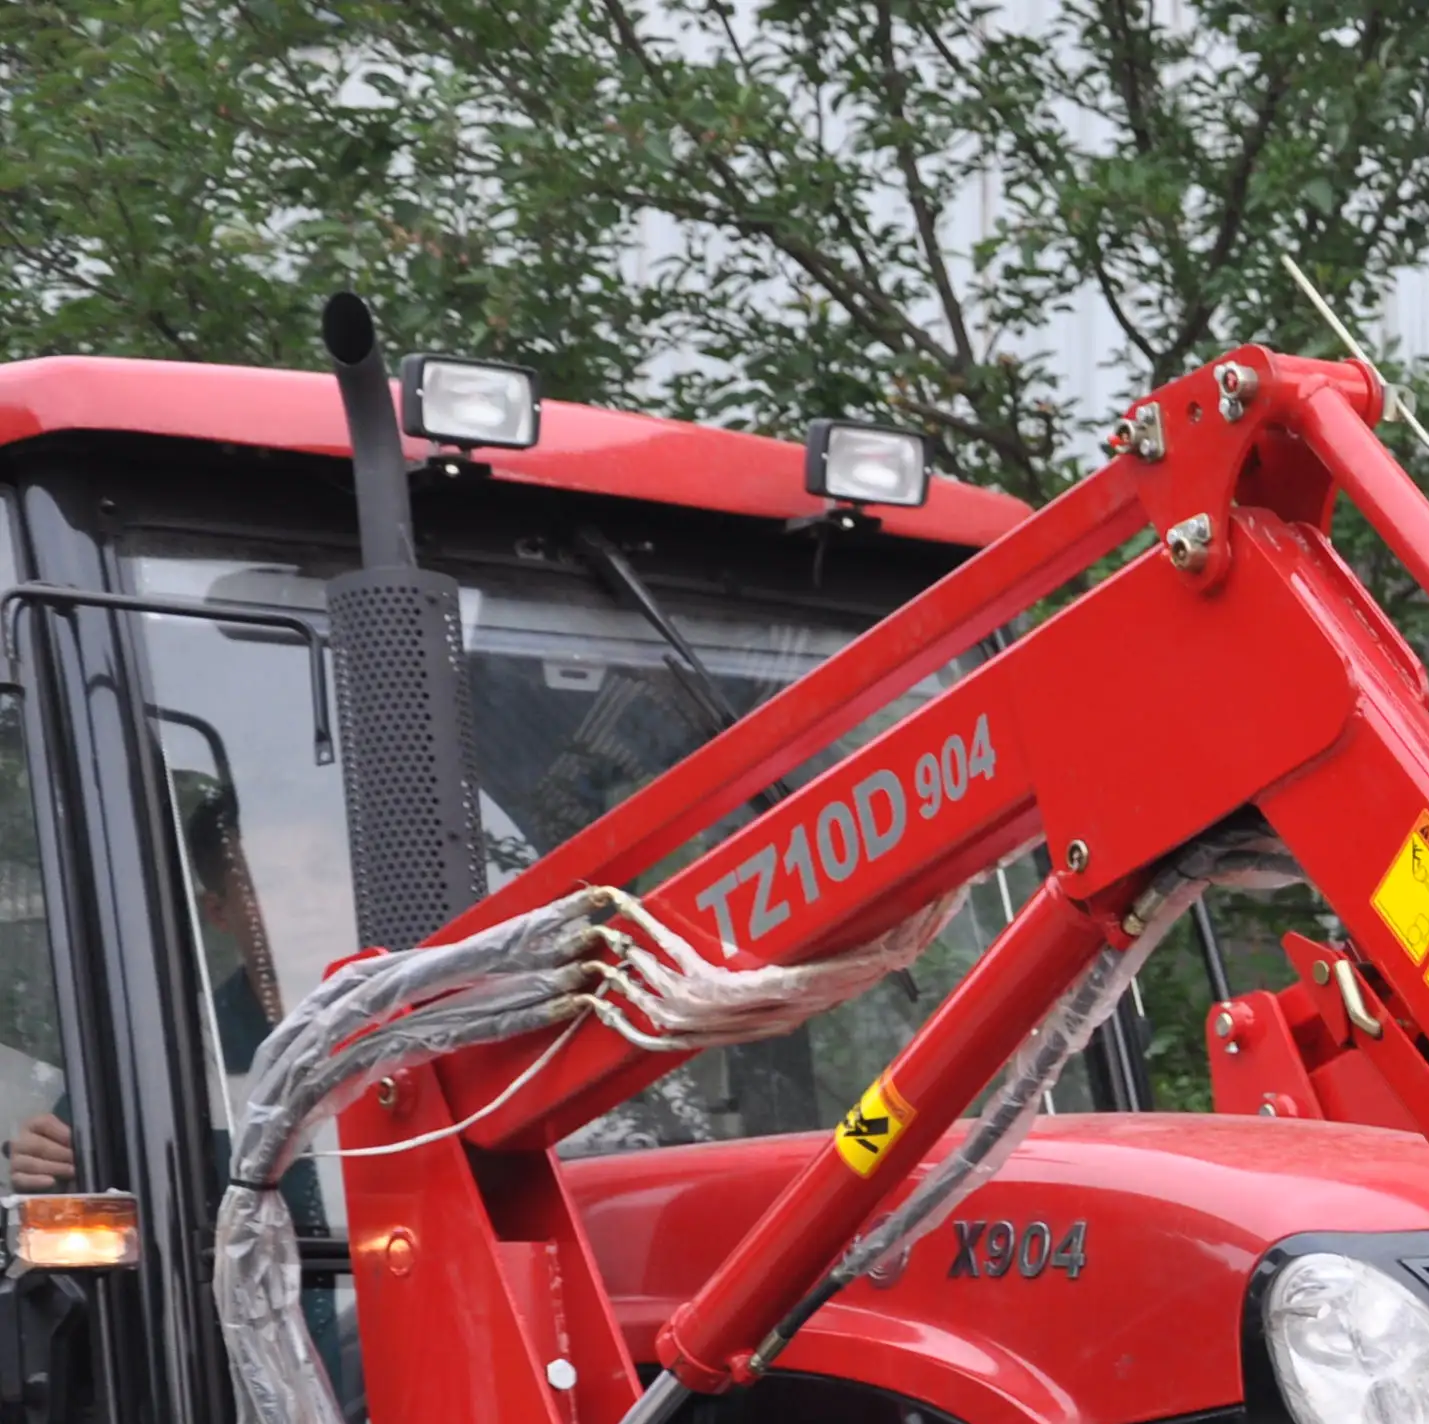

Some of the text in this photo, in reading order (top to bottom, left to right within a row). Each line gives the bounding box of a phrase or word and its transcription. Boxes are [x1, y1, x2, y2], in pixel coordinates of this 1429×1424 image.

[695, 712, 997, 959] TZ10D 904
[946, 1218, 1089, 1281] X904
